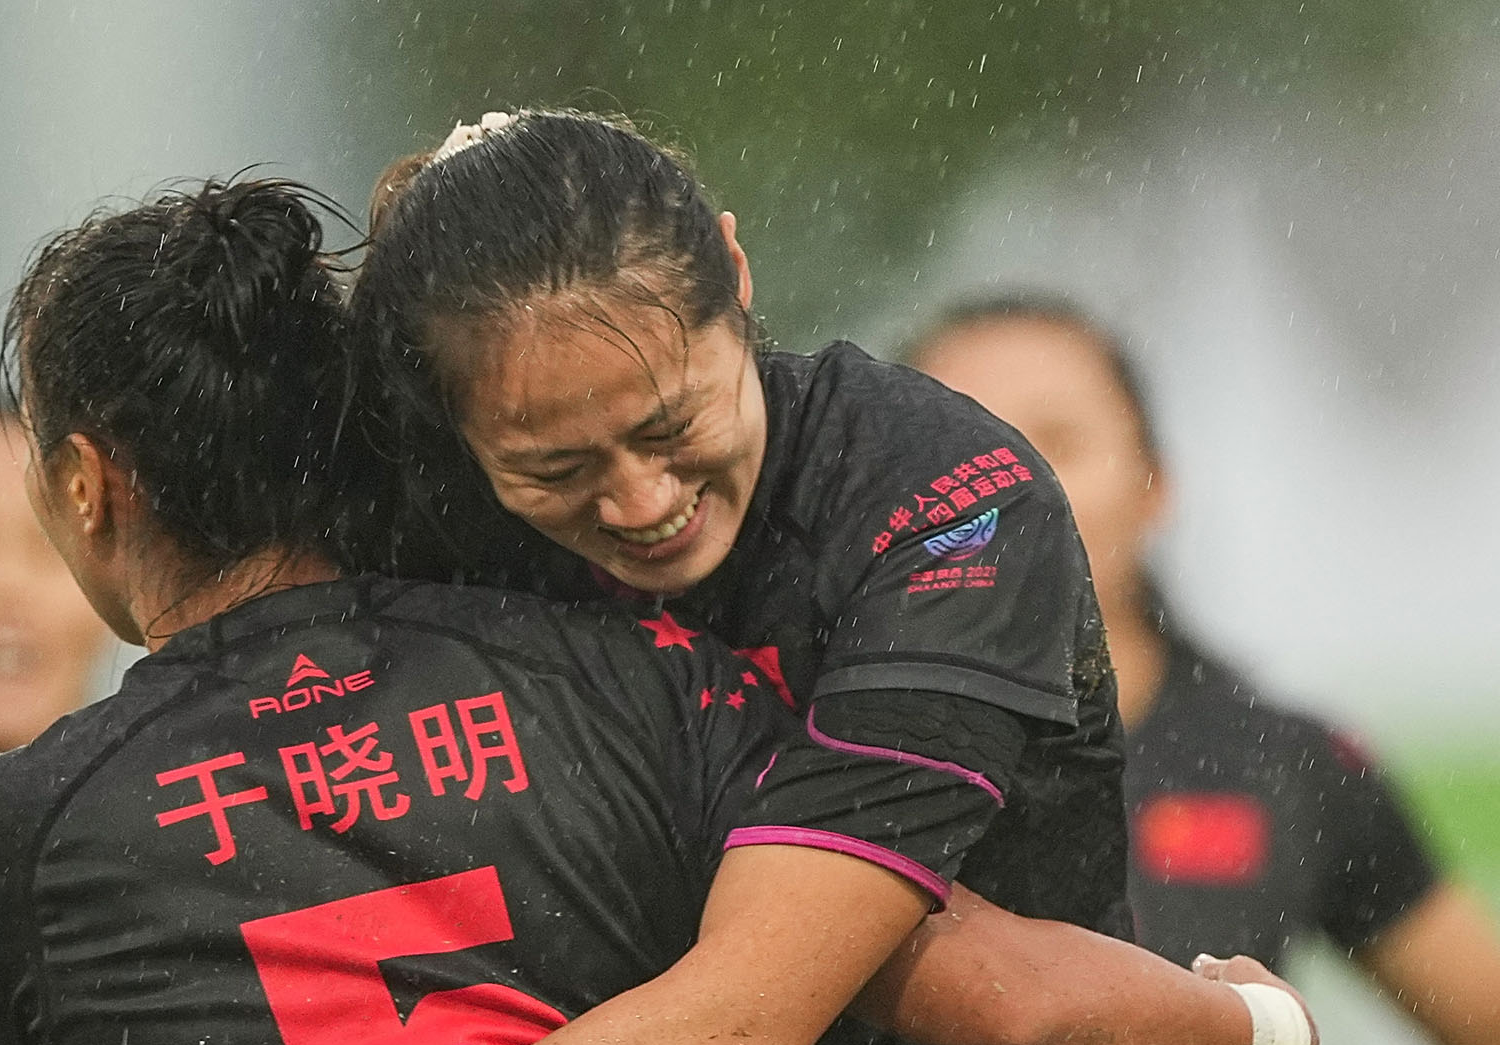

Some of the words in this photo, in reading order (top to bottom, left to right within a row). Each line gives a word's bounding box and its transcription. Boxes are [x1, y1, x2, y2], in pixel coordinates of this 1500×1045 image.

[871, 447, 1020, 554] 中华人民共和国
[911, 464, 1033, 533] 四届运动会
[249, 669, 375, 719] AONE
[155, 691, 529, 866] 于晓明
